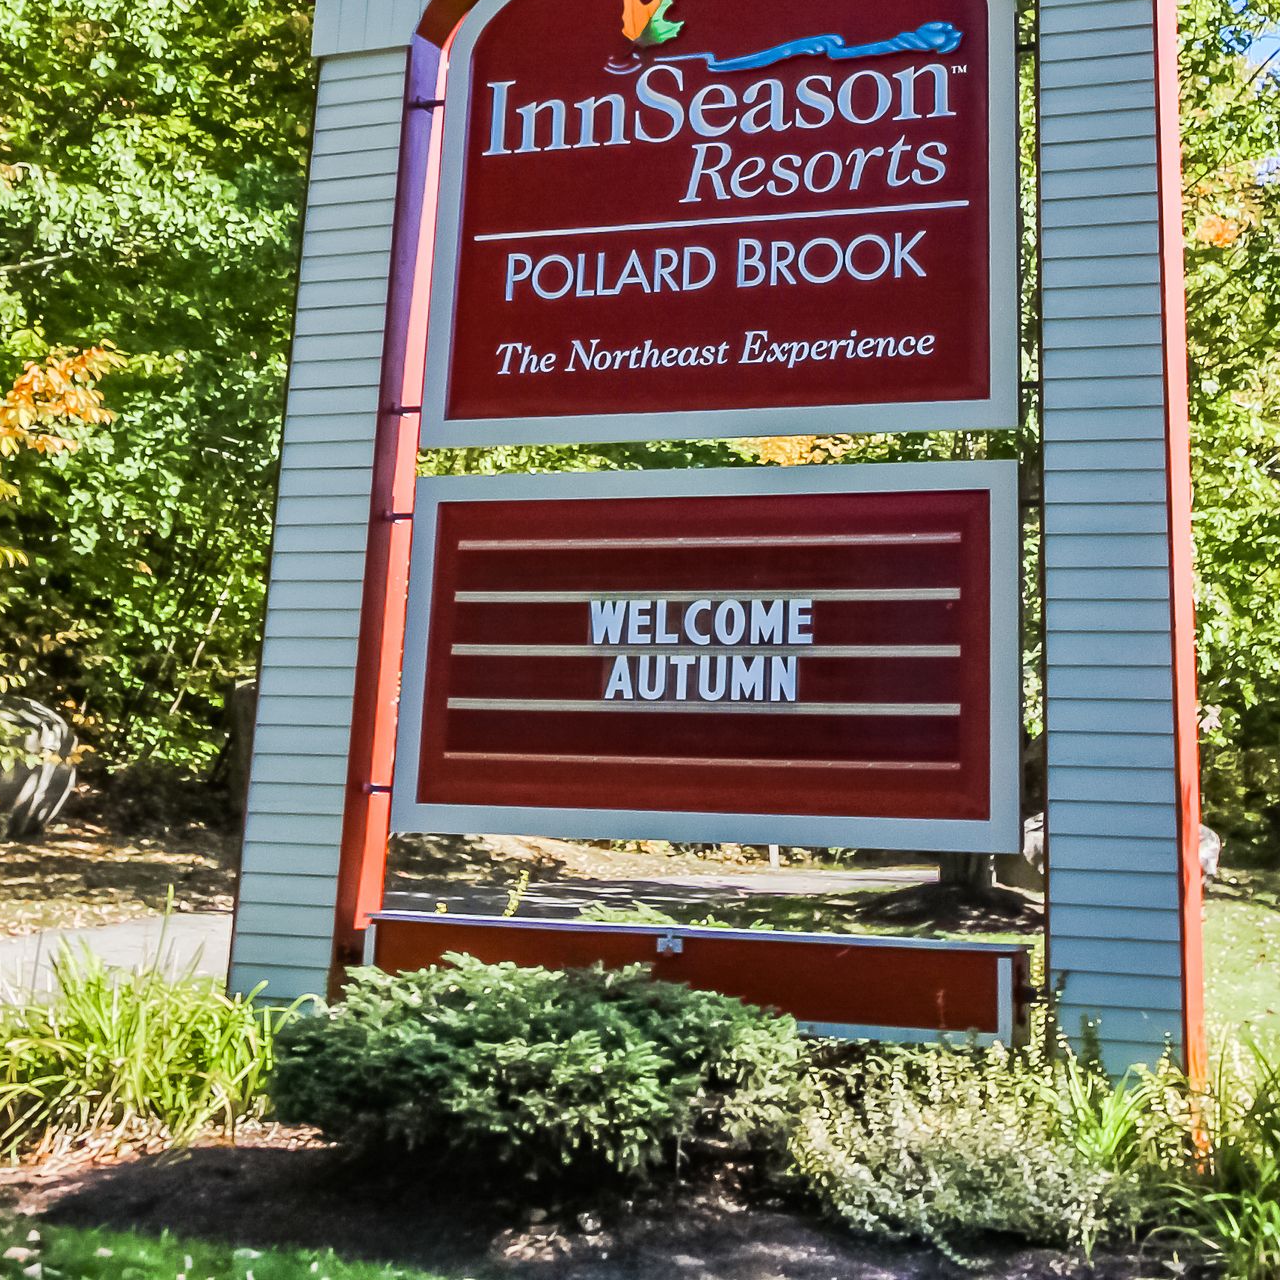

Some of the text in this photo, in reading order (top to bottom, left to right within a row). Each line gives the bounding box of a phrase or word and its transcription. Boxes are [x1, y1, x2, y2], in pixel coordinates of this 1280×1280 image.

[481, 63, 957, 157] InnSeason
[679, 134, 948, 204] Resorts
[505, 230, 927, 302] POLLARD BROOK
[495, 329, 937, 375] The Northeast Experience
[589, 599, 814, 645] WELCOME
[604, 655, 797, 701] AUTUMN
